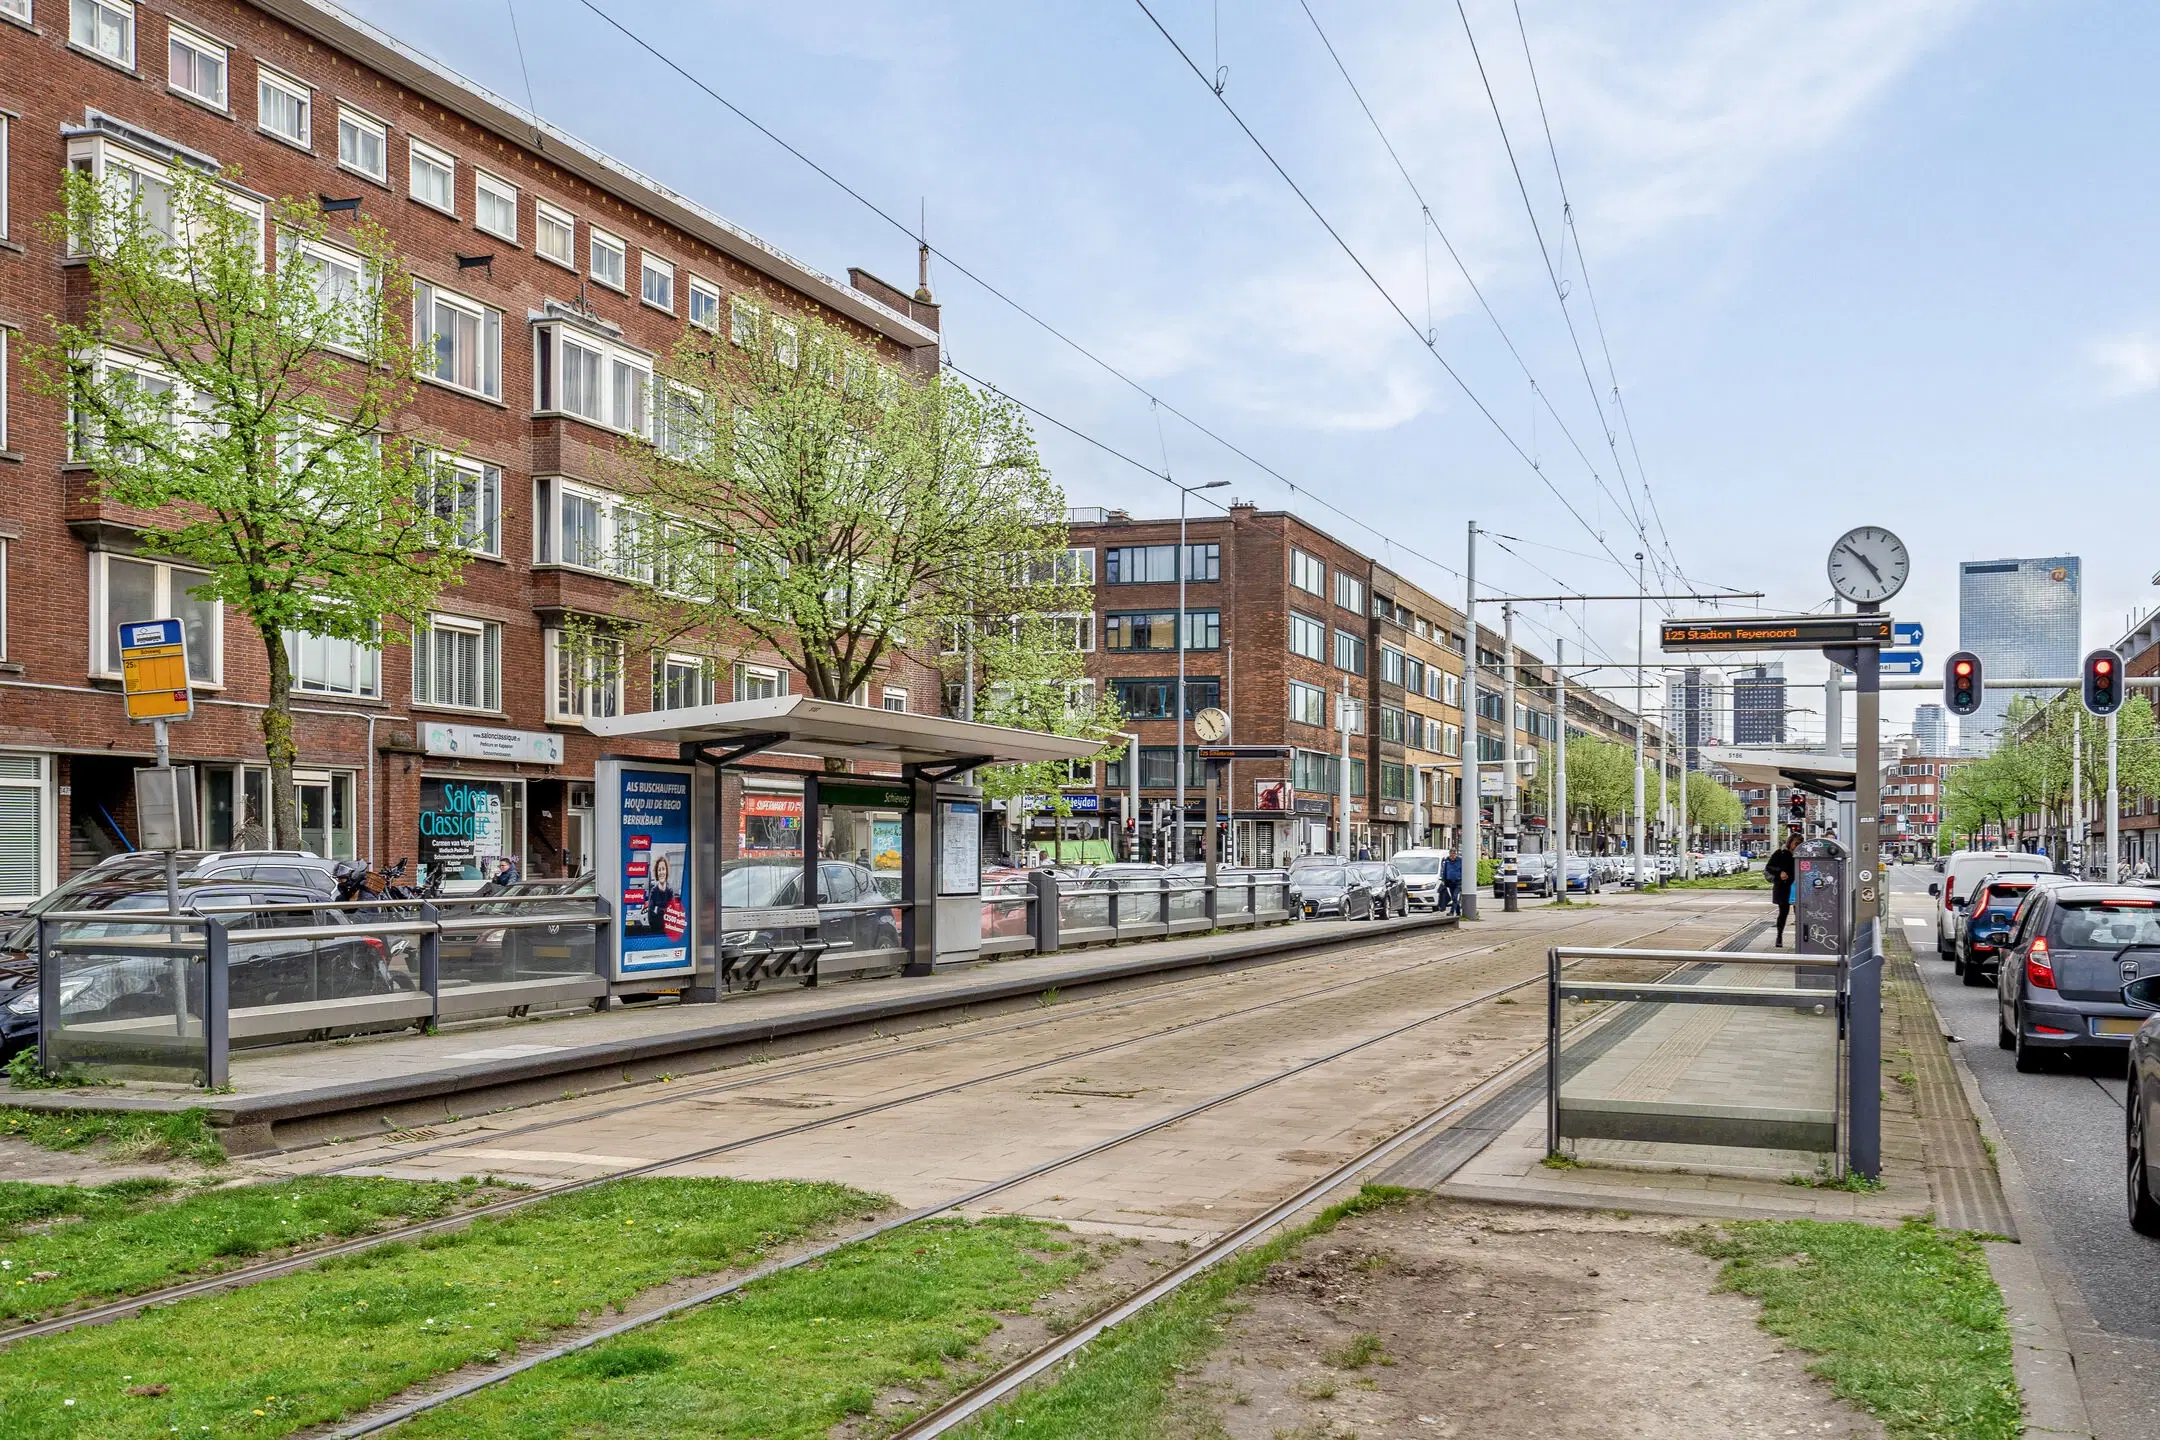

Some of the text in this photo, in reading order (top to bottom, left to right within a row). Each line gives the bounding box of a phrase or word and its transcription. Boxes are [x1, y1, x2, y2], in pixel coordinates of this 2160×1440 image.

[1665, 625, 1889, 640] 125 Stadion Feyenoord 2
[626, 781, 687, 795] ALS BUSCHAUFFEUR
[444, 784, 490, 813] Salon
[624, 798, 645, 809] HOUD
[654, 799, 663, 809] DE
[663, 800, 682, 810] REGIO
[884, 792, 911, 806] Schieweg
[420, 811, 491, 840] Classique
